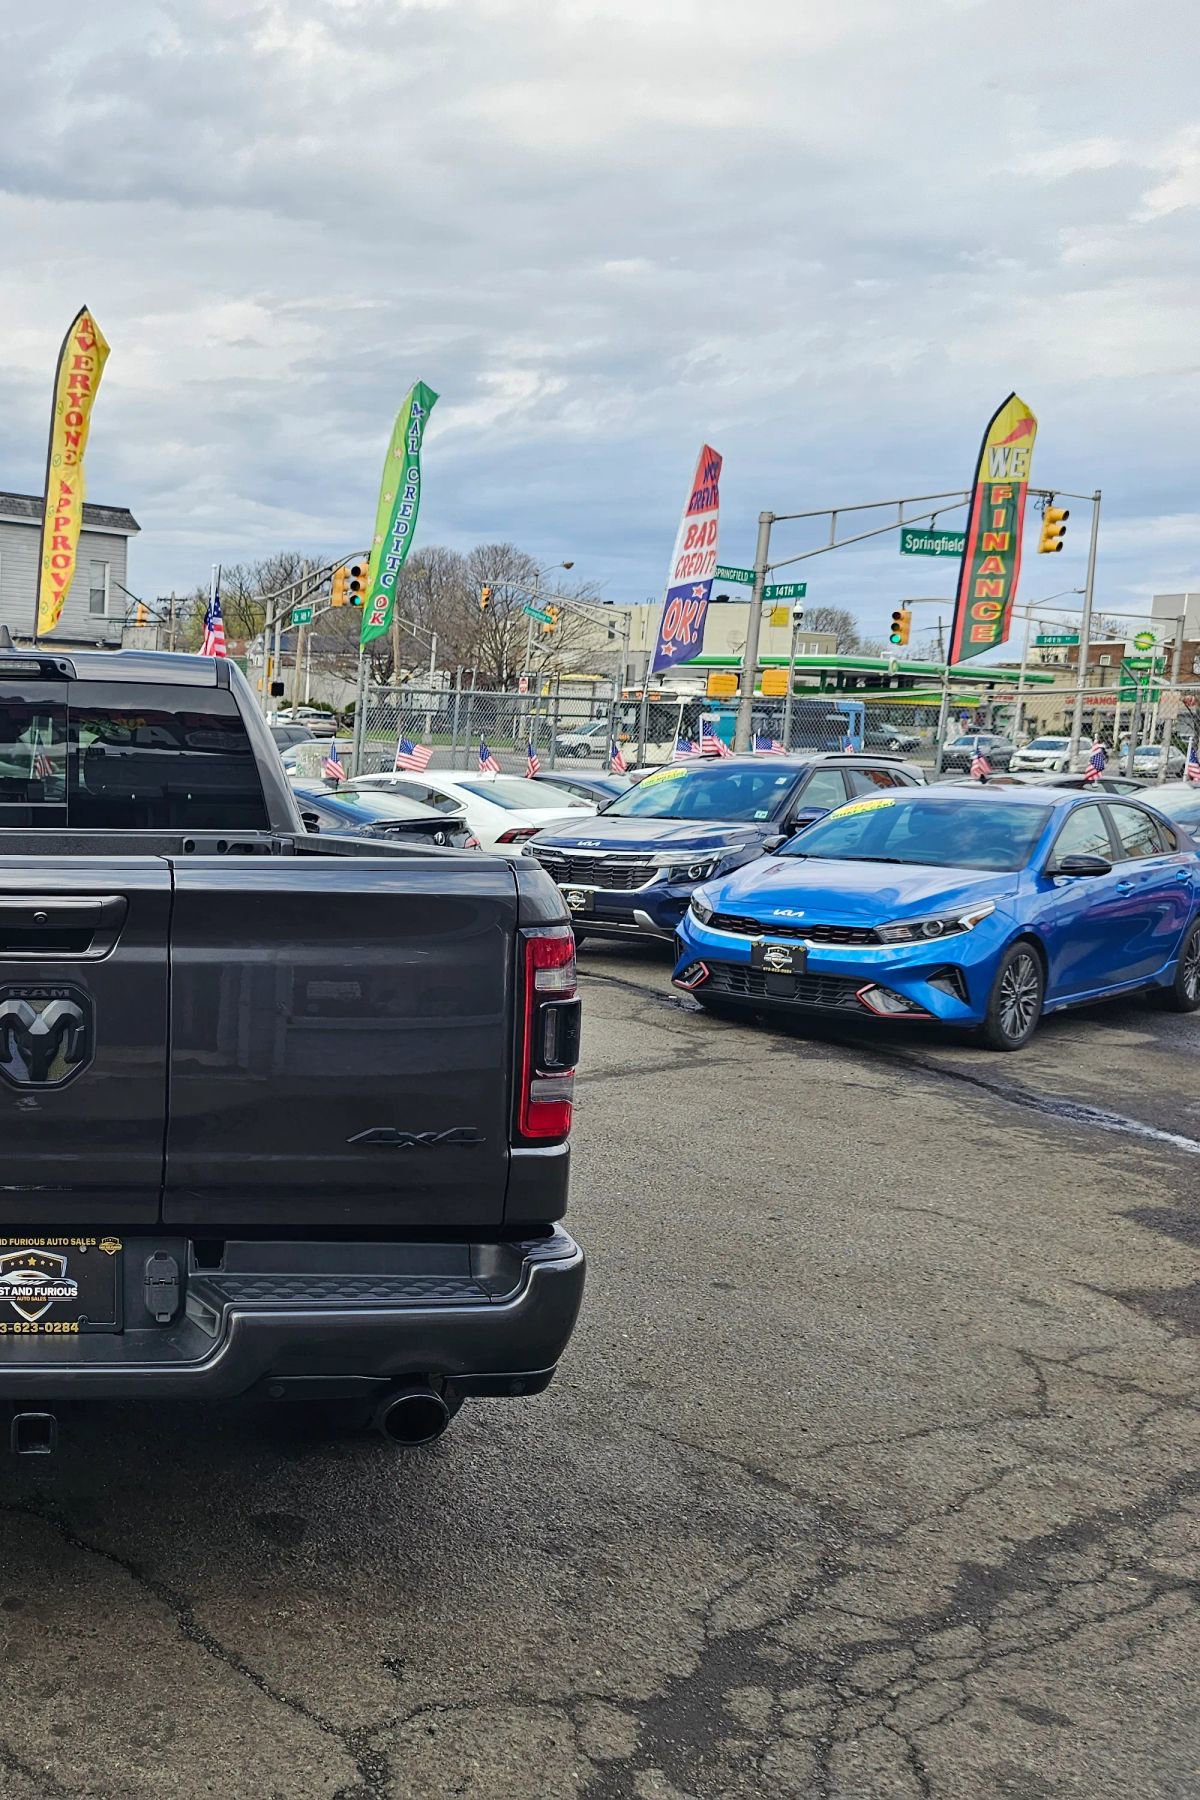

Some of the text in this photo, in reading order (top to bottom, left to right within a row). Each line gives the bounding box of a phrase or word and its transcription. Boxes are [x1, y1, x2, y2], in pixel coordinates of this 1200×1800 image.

[987, 446, 1029, 479] WE
[684, 518, 717, 551] BAD
[905, 534, 965, 555] Springfield
[49, 479, 74, 622] APPROV
[715, 566, 749, 582] SPRINGFIELD
[969, 485, 1012, 643] FINANCE
[765, 586, 771, 597] S
[775, 585, 794, 597] 14TH
[368, 594, 389, 626] OK
[661, 597, 708, 646] OK!
[8, 988, 70, 997] RAM
[9, 1238, 46, 1246] FURIOUS
[47, 1238, 68, 1246] AUTO
[70, 1237, 97, 1246] SALES
[12, 1287, 33, 1296] AND
[34, 1287, 78, 1297] FURIOUS
